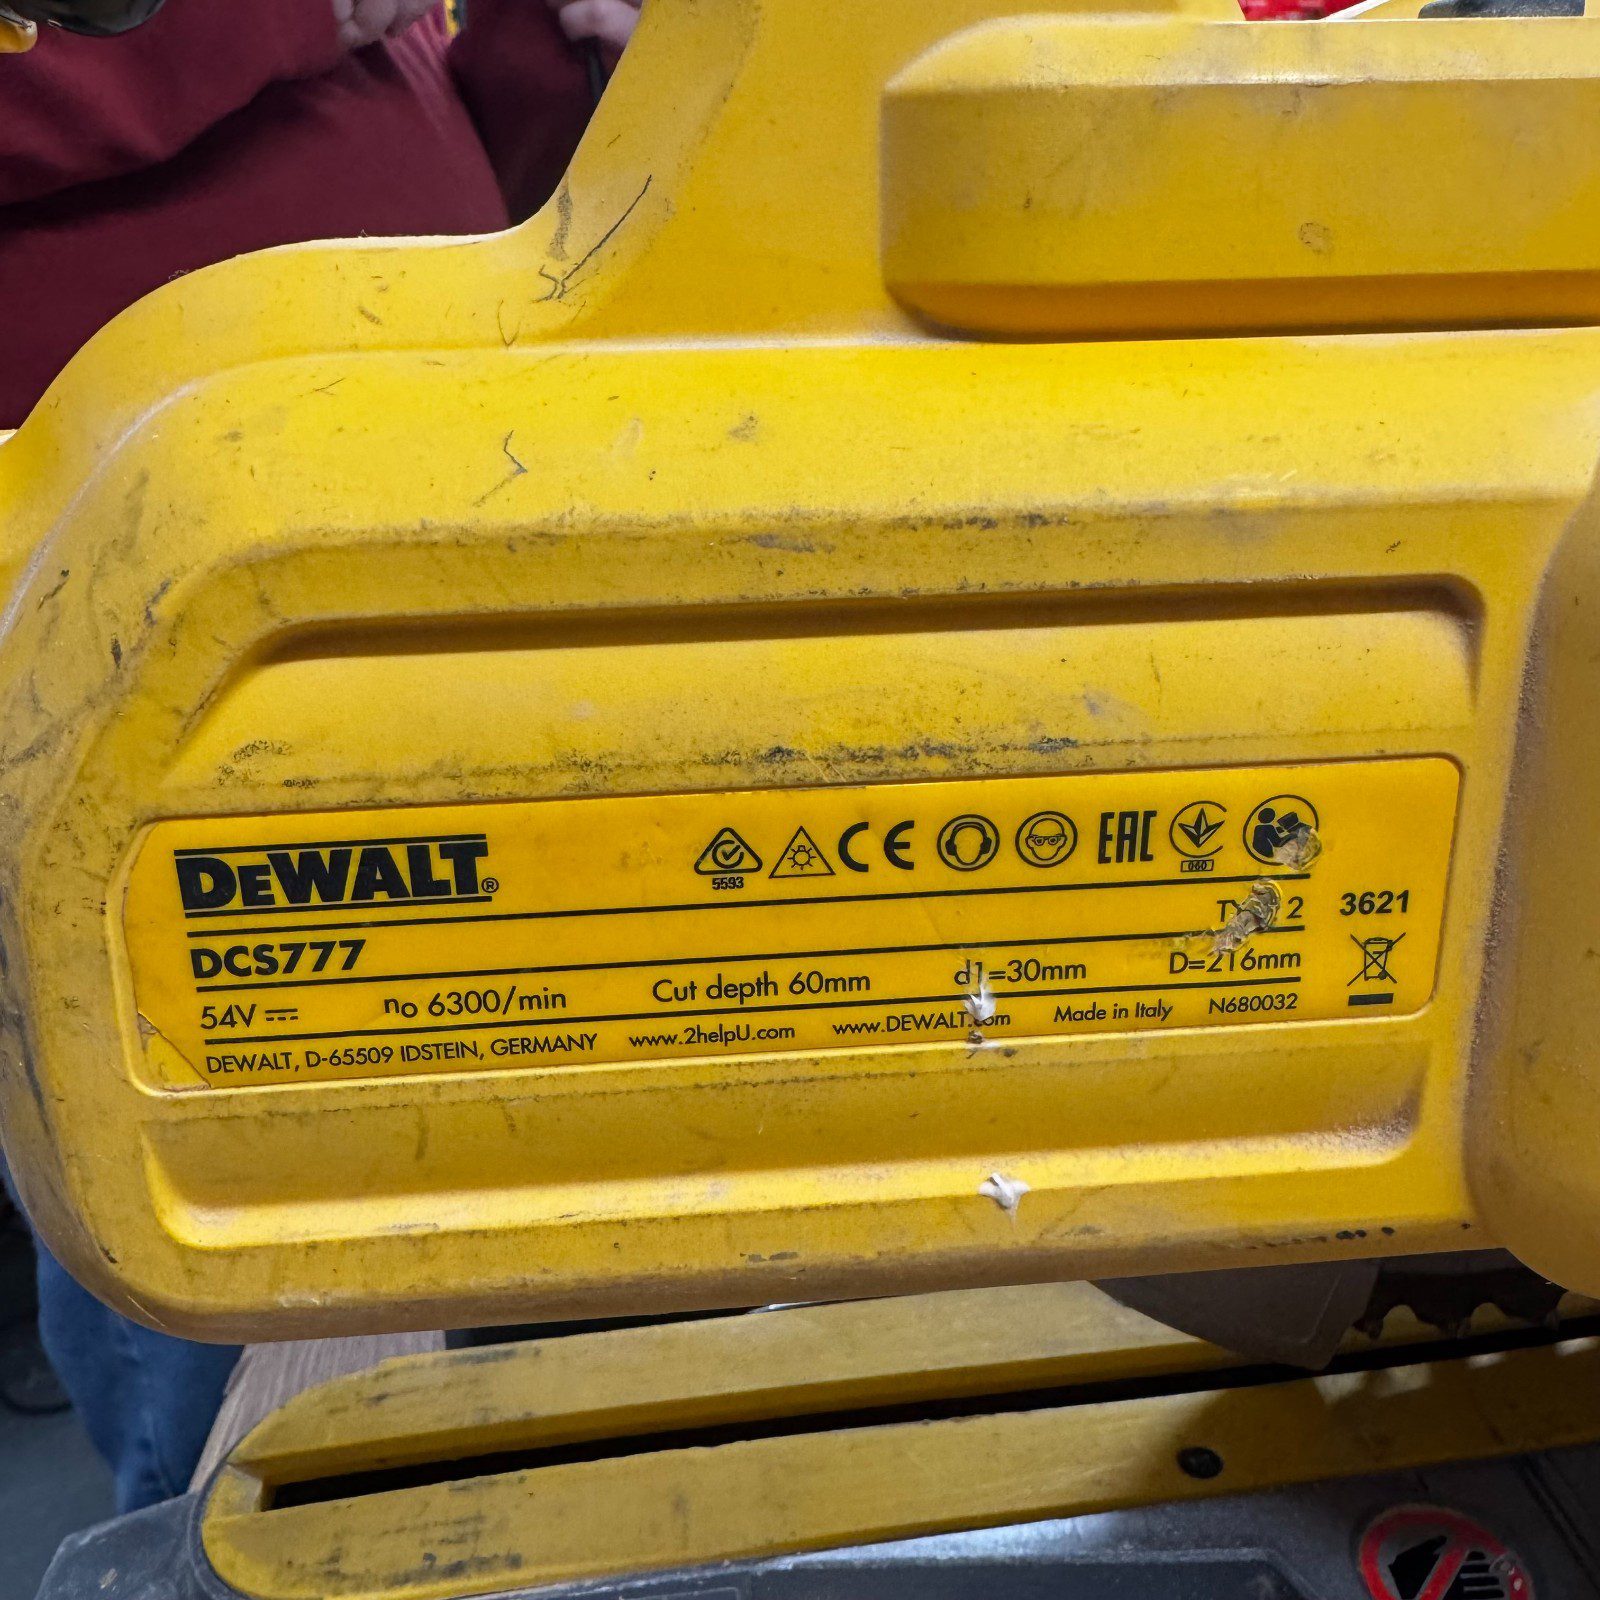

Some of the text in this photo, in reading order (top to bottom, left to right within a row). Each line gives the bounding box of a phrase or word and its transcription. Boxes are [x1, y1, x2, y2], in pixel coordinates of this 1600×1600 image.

[838, 820, 915, 872] CE
[1097, 810, 1157, 864] EAC
[711, 876, 745, 891] 5593
[1286, 896, 1304, 920] 2
[1339, 889, 1409, 917] 3621
[190, 939, 367, 979] DCS777
[428, 985, 567, 1017] 6300/min
[652, 970, 871, 1004] Cut depth 60mm
[200, 1003, 257, 1030] 54V
[1053, 998, 1174, 1023] Made in Italy
[1208, 992, 1298, 1015] N680032
[628, 1023, 796, 1048] www.2helpU.com
[205, 1033, 598, 1074] DEWALT, D-65509 IDSTEIN, GERMANY
